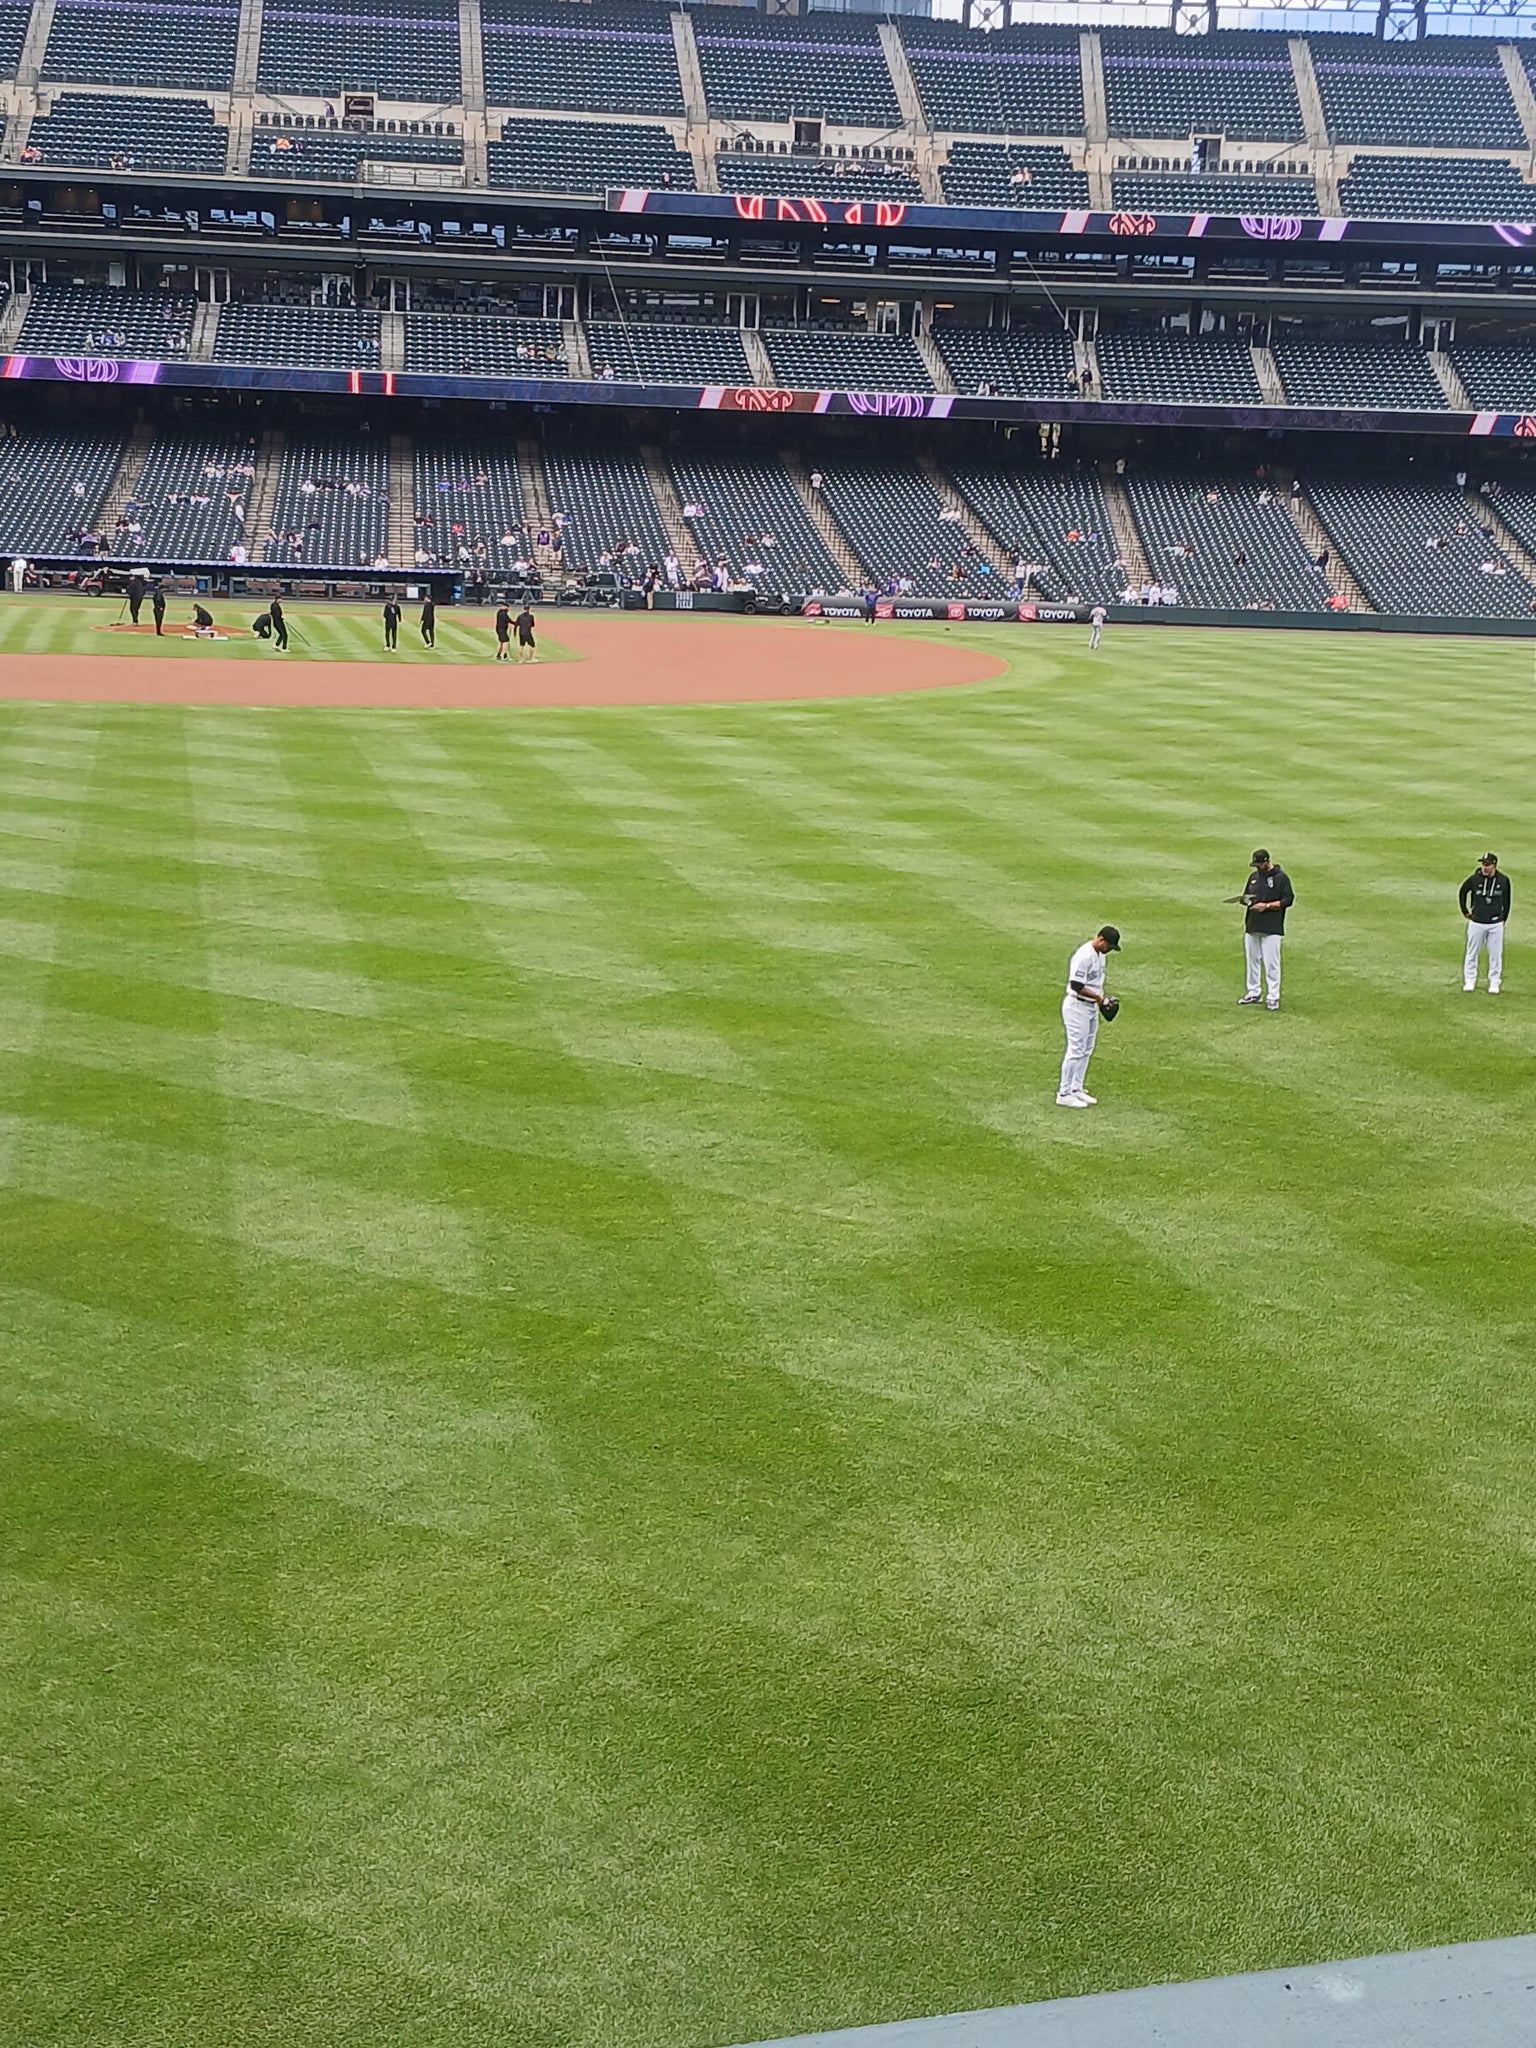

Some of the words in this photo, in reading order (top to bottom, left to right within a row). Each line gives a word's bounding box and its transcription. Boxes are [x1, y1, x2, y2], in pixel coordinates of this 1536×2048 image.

[822, 607, 861, 617] TOYOTA
[895, 608, 933, 618] TOYOTA
[966, 608, 1005, 618] TOYOTA
[1038, 609, 1076, 620] TOYOTA
